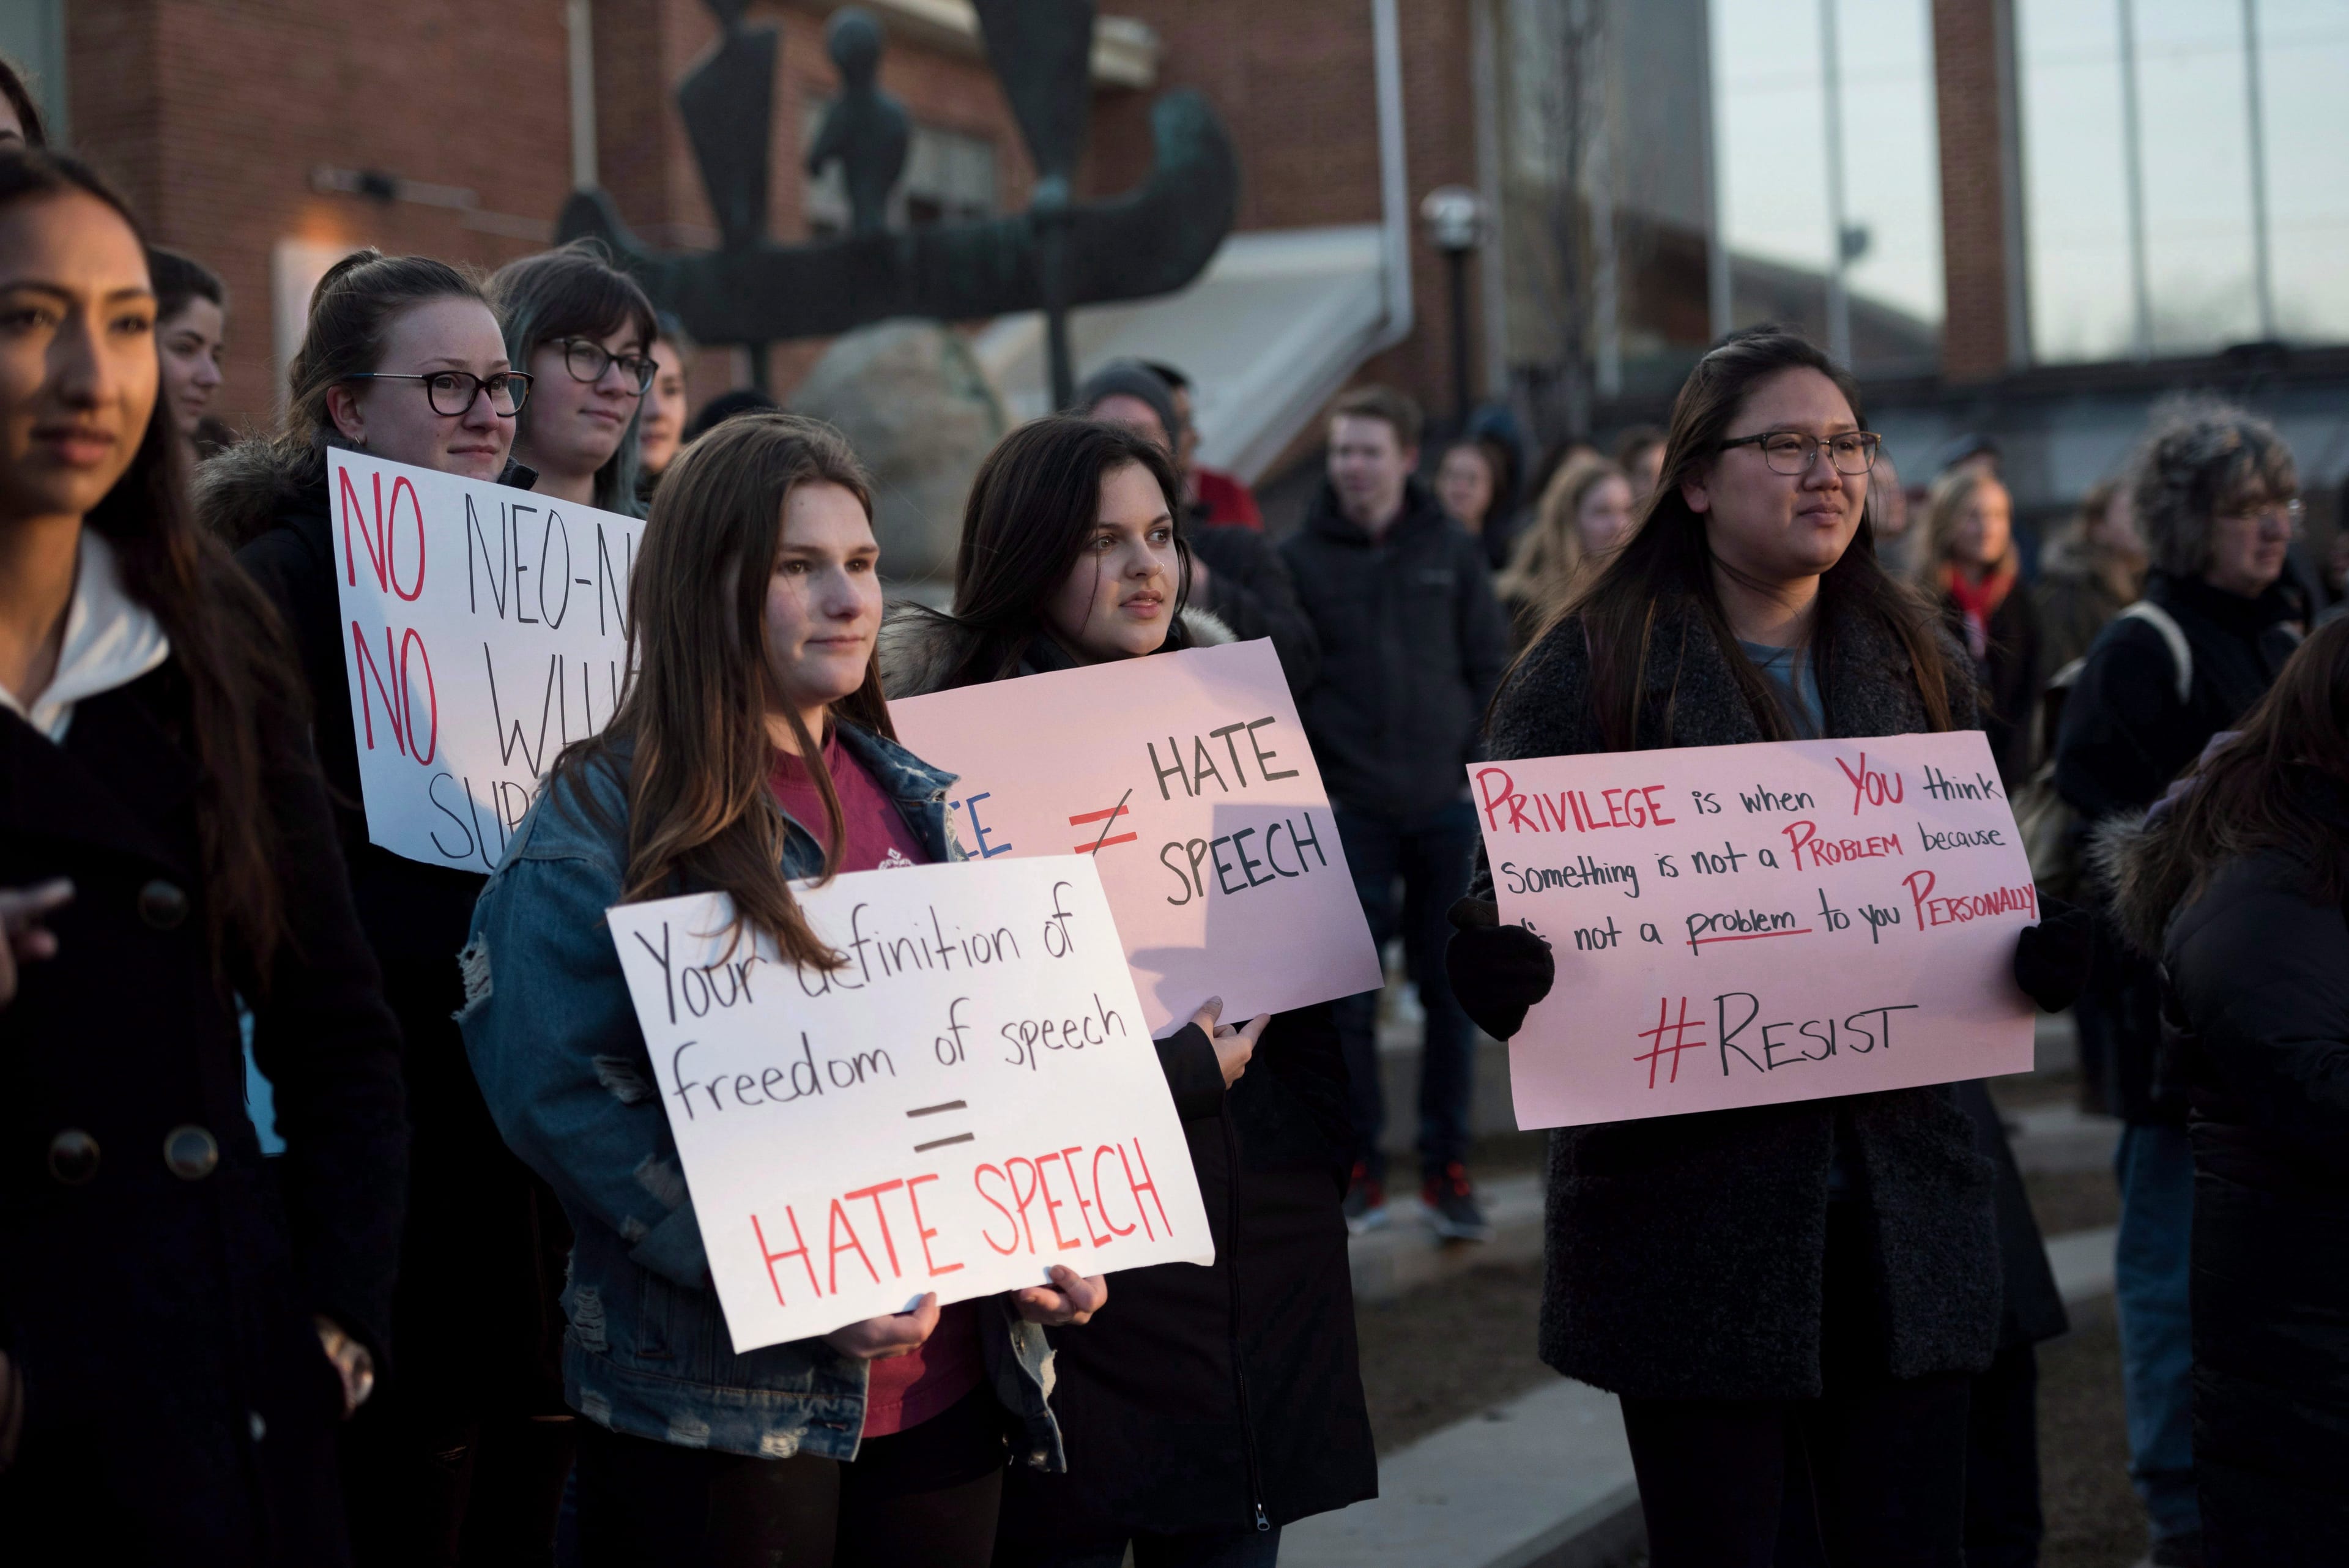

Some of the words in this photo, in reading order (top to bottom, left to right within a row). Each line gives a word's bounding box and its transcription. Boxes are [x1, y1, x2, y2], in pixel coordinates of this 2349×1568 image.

[338, 466, 425, 601] NO
[466, 493, 632, 642] NEO-N
[352, 620, 437, 766] NO
[1147, 716, 1299, 801] HATE
[1475, 767, 1676, 833] PRIVILEGE
[1692, 790, 1721, 816] is
[1740, 783, 1816, 813] when
[1923, 764, 2003, 803] think
[429, 772, 530, 870] SUP
[1160, 812, 1327, 905] SPEECH
[1655, 852, 1679, 879] is
[1691, 841, 1747, 875] not
[1758, 848, 1779, 869] a
[1781, 820, 1904, 872] PROBLEM
[1918, 821, 2006, 853] because
[634, 921, 768, 1024] Your
[1044, 881, 1073, 959] of
[1574, 915, 1622, 951] not
[1639, 921, 1664, 946] a
[1687, 907, 1797, 957] problem
[1818, 888, 1851, 933] to
[1859, 903, 1902, 945] you
[1901, 869, 2036, 932] PERSONALLY
[672, 1031, 896, 1120] freedom
[935, 997, 970, 1066] of
[1001, 993, 1127, 1071] speech
[1633, 991, 1919, 1090] #RESIST
[750, 1173, 965, 1306] HATE
[974, 1136, 1173, 1256] SPEECH
